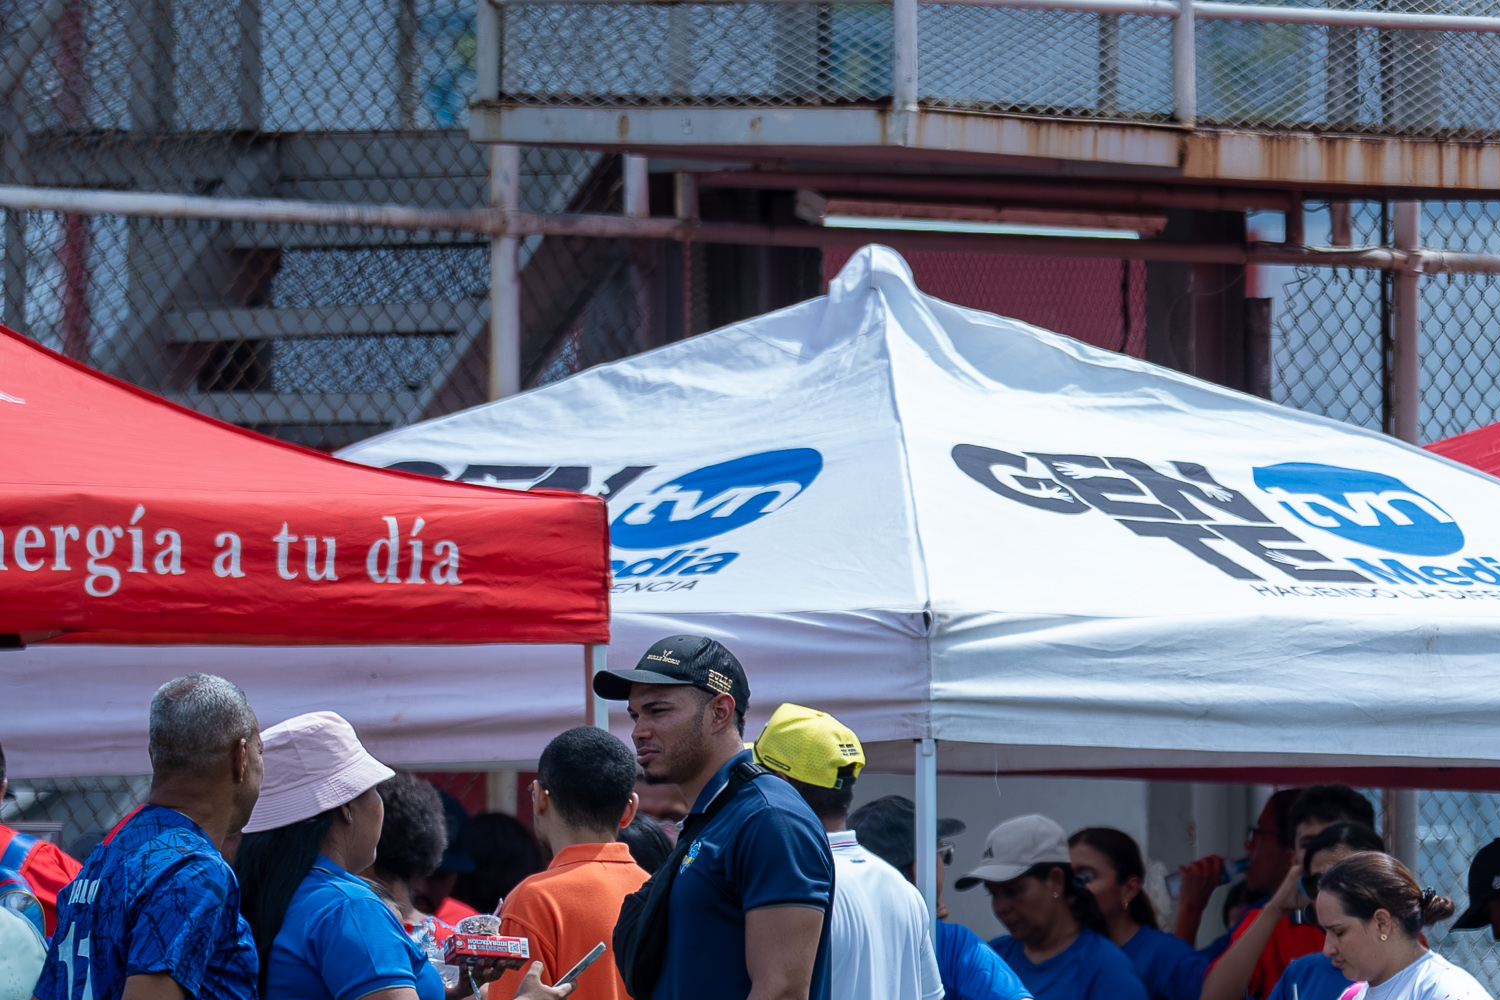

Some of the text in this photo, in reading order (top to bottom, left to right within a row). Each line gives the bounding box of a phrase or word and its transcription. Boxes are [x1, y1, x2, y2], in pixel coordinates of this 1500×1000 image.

[622, 481, 803, 525] tvn
[1263, 485, 1458, 530] tvn
[213, 531, 246, 578] a
[272, 521, 338, 581] tu
[366, 516, 463, 585] día
[1250, 584, 1399, 600] HACIENDO
[1407, 588, 1443, 600] LA
